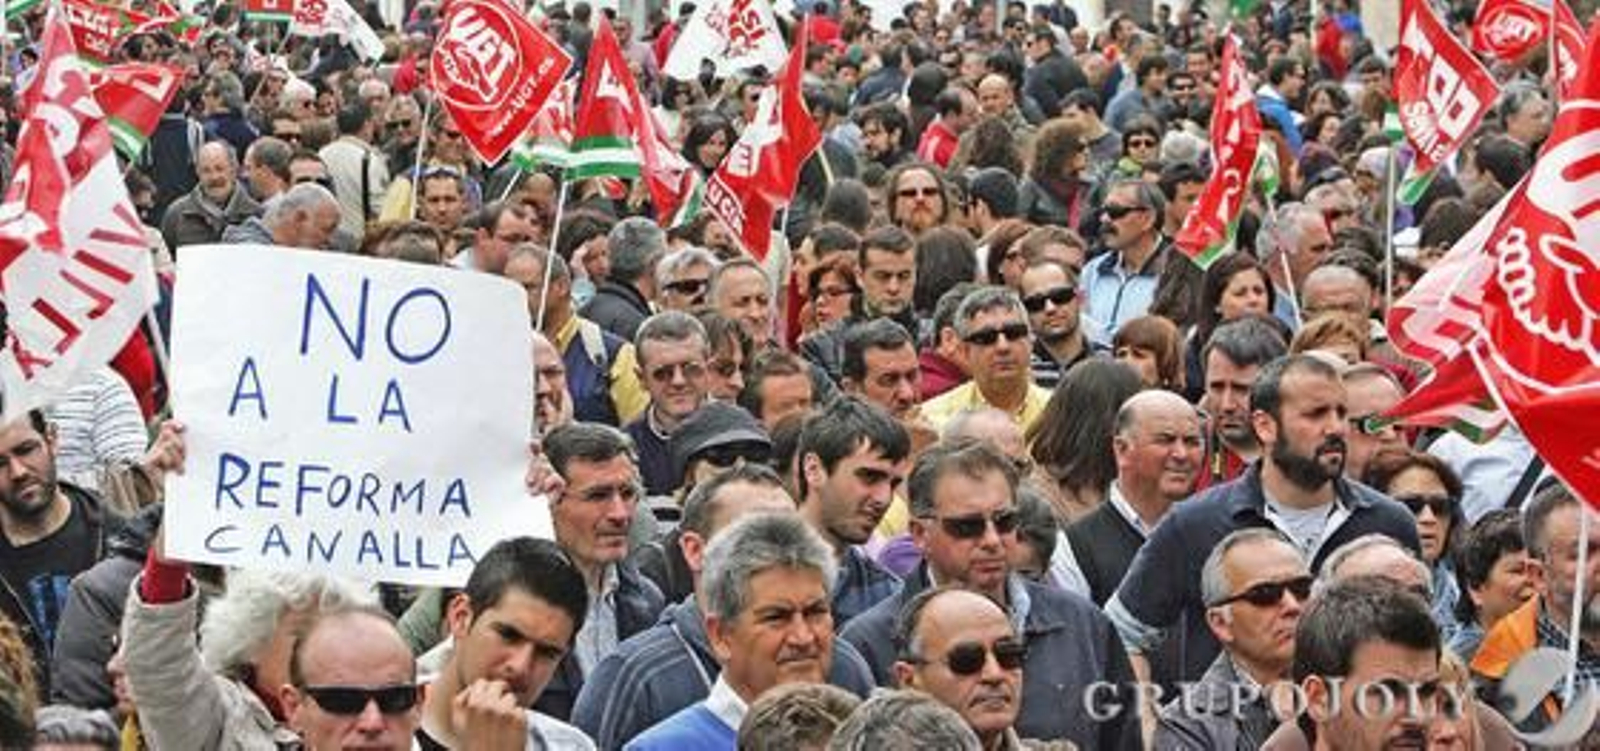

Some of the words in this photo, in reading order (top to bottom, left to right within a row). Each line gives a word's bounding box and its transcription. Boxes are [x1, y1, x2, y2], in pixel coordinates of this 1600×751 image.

[448, 7, 517, 90] UGT
[300, 272, 452, 364] NO
[228, 356, 268, 421] A
[327, 374, 412, 433] LA
[215, 452, 471, 517] REFORMA
[204, 524, 478, 570] CANALLA
